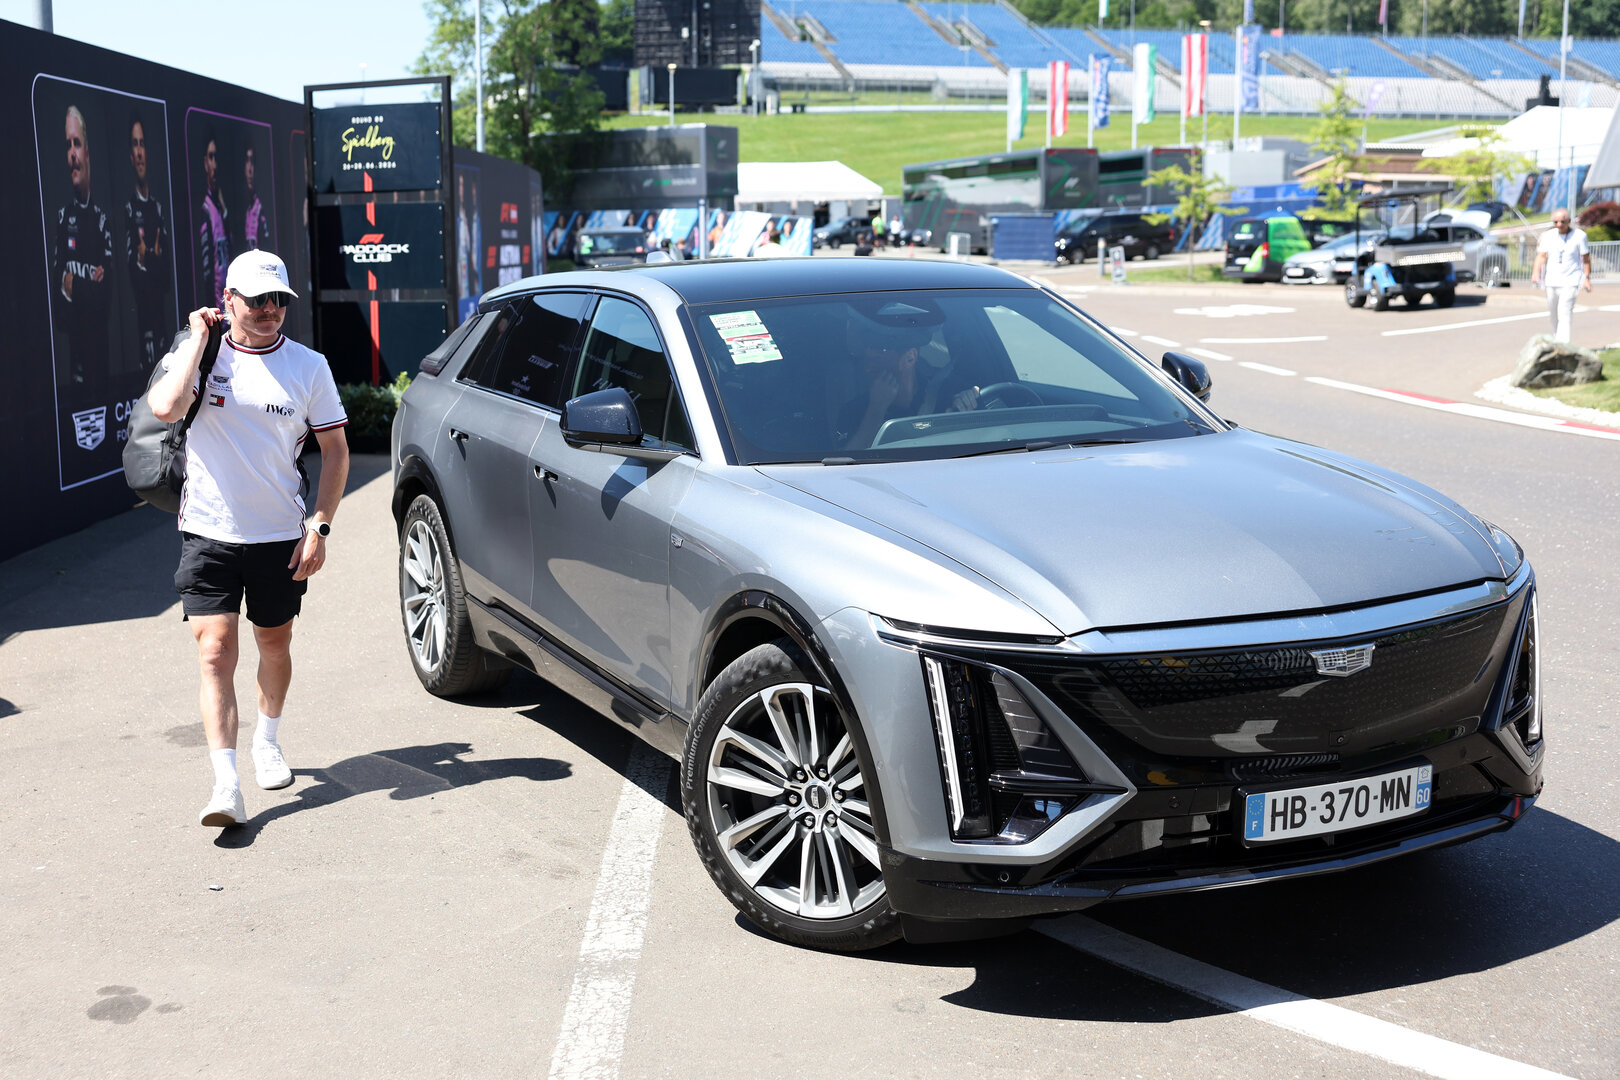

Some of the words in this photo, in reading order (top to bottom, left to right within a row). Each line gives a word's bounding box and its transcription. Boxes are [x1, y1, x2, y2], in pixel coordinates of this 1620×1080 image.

[341, 124, 396, 162] Spielberg
[340, 244, 409, 254] PADDOCK
[353, 253, 392, 263] CLUB
[265, 402, 288, 417] TWG
[716, 691, 723, 702] 6
[1417, 787, 1430, 804] 60
[1270, 775, 1412, 832] HB-370-MN
[1252, 821, 1258, 831] F
